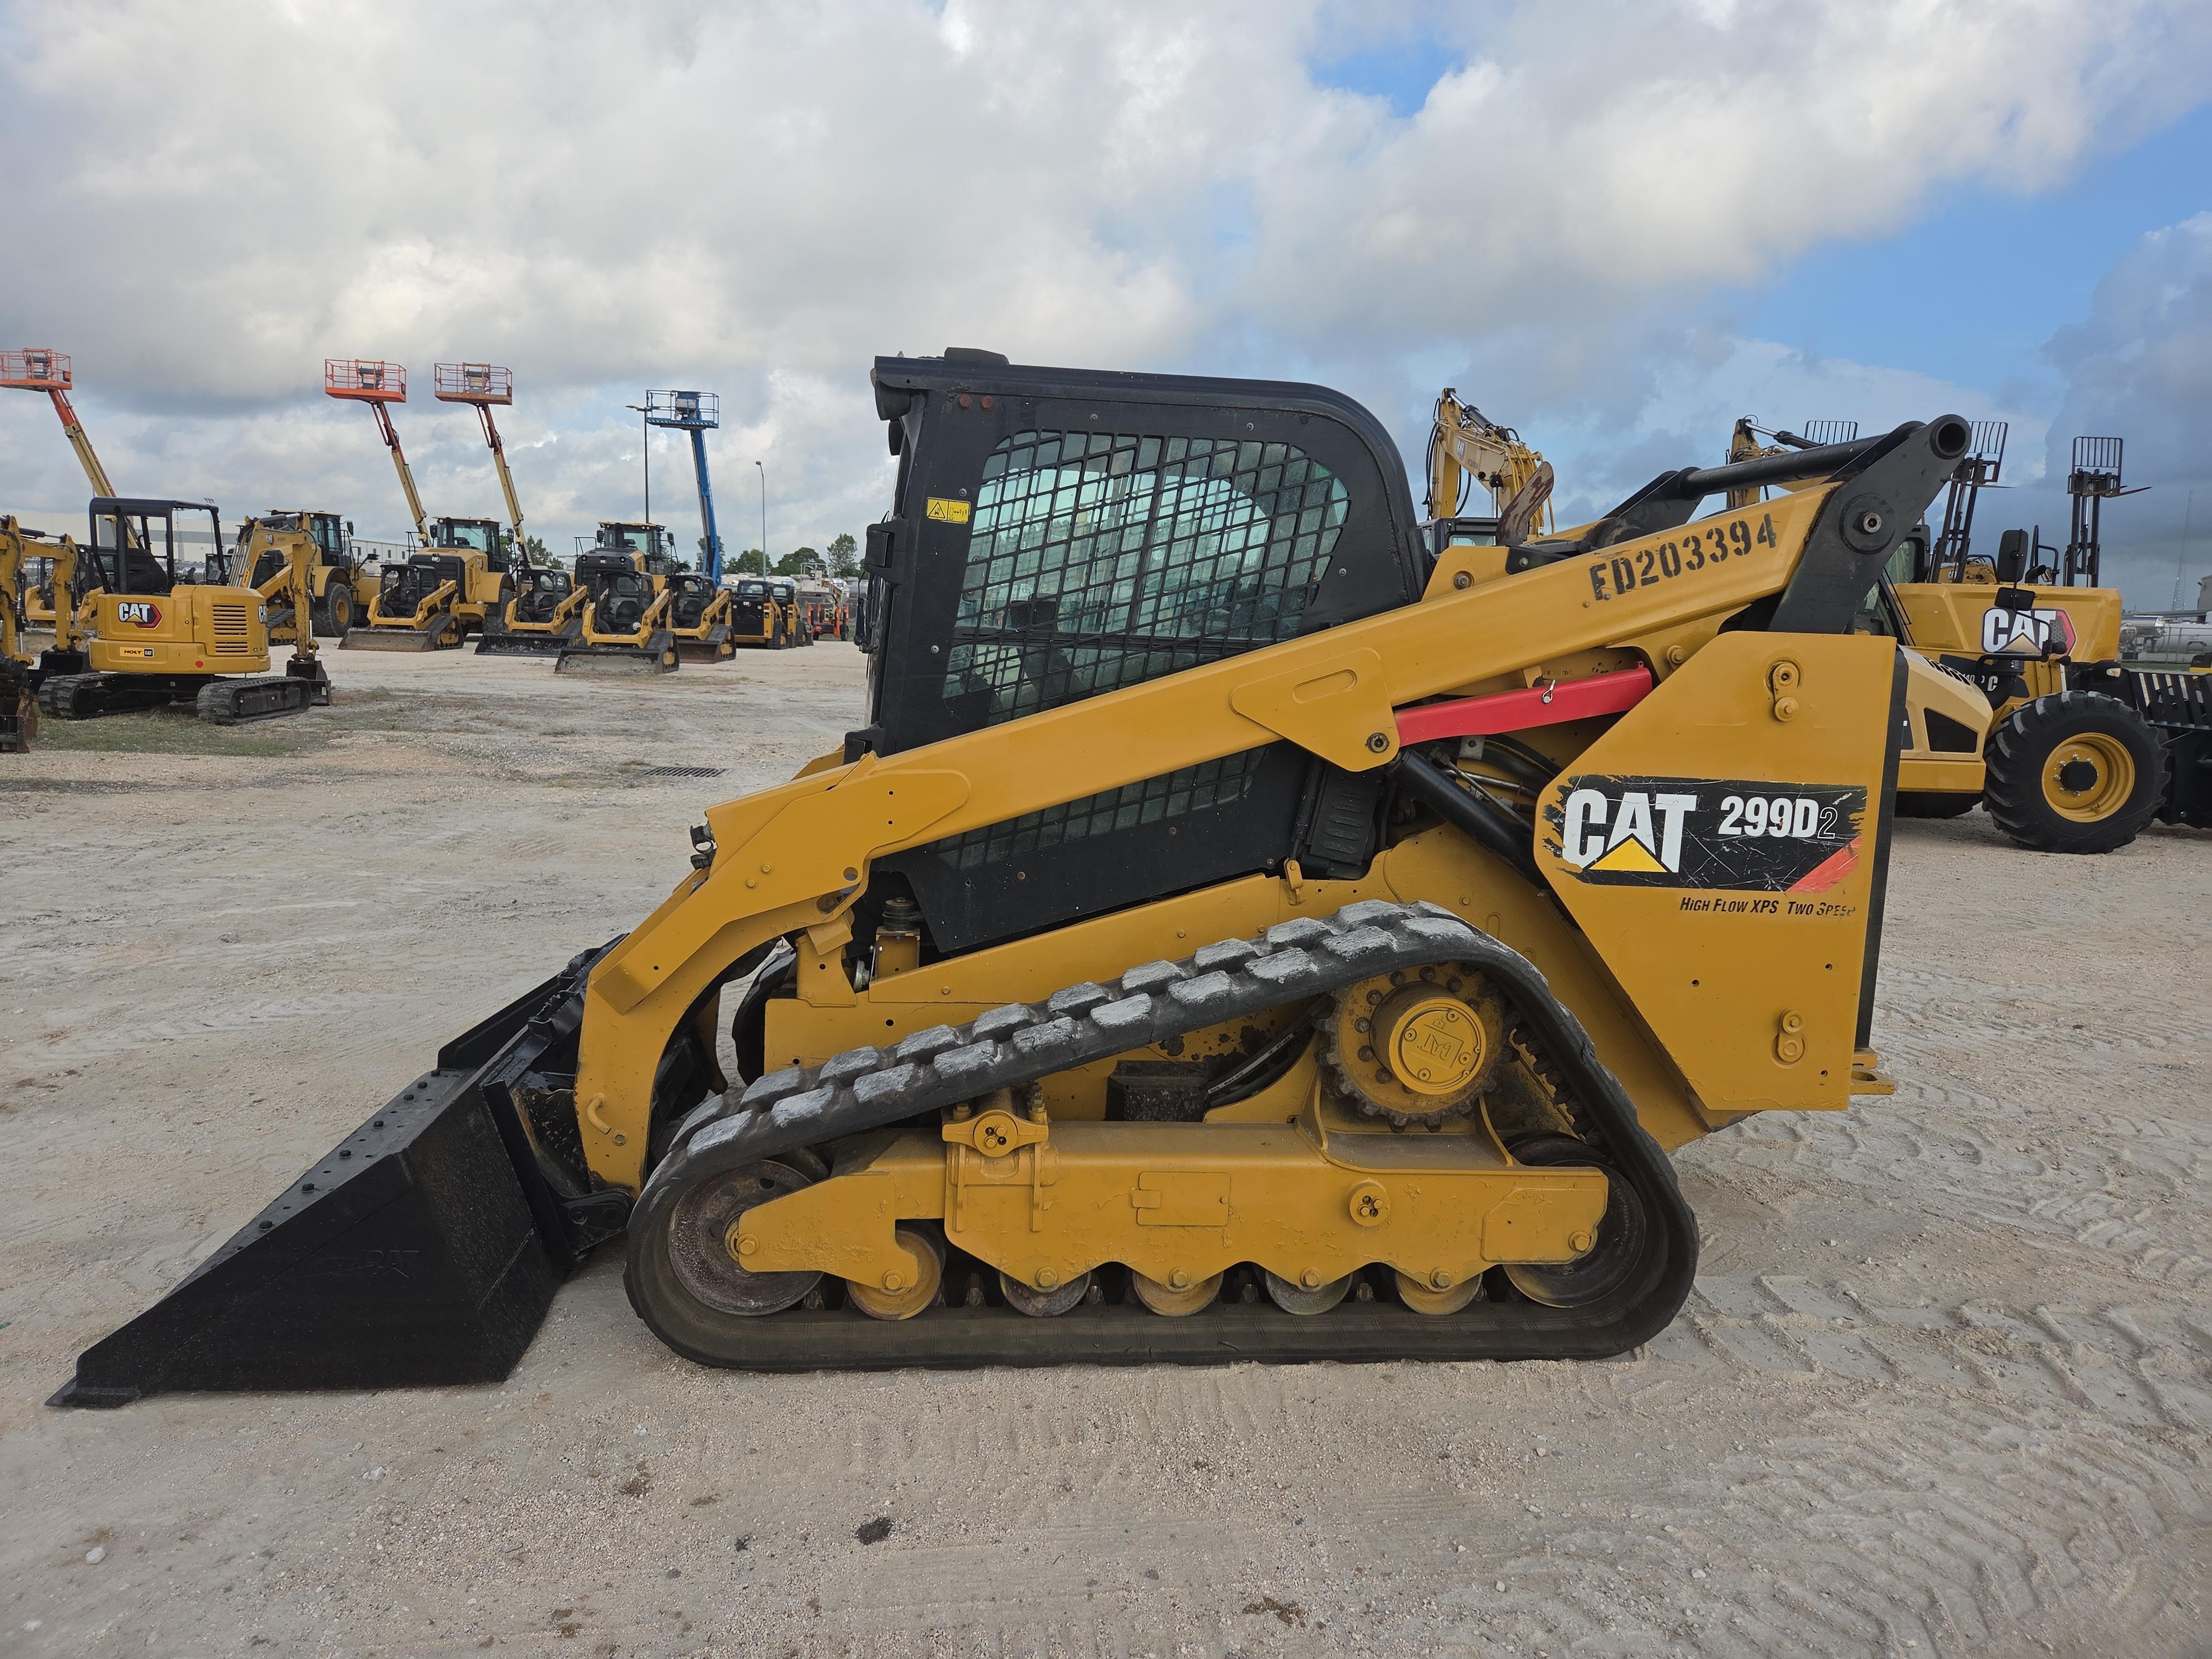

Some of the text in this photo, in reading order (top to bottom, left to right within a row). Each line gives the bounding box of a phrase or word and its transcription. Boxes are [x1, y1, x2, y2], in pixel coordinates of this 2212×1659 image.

[1589, 513, 1777, 601] ED203394
[119, 603, 150, 622] CAT
[1983, 608, 2056, 653] CAT
[1562, 789, 1697, 873] CAT
[1713, 898, 1748, 912] FLOW
[1750, 899, 1779, 914] XPS
[1787, 901, 1814, 915] TWO
